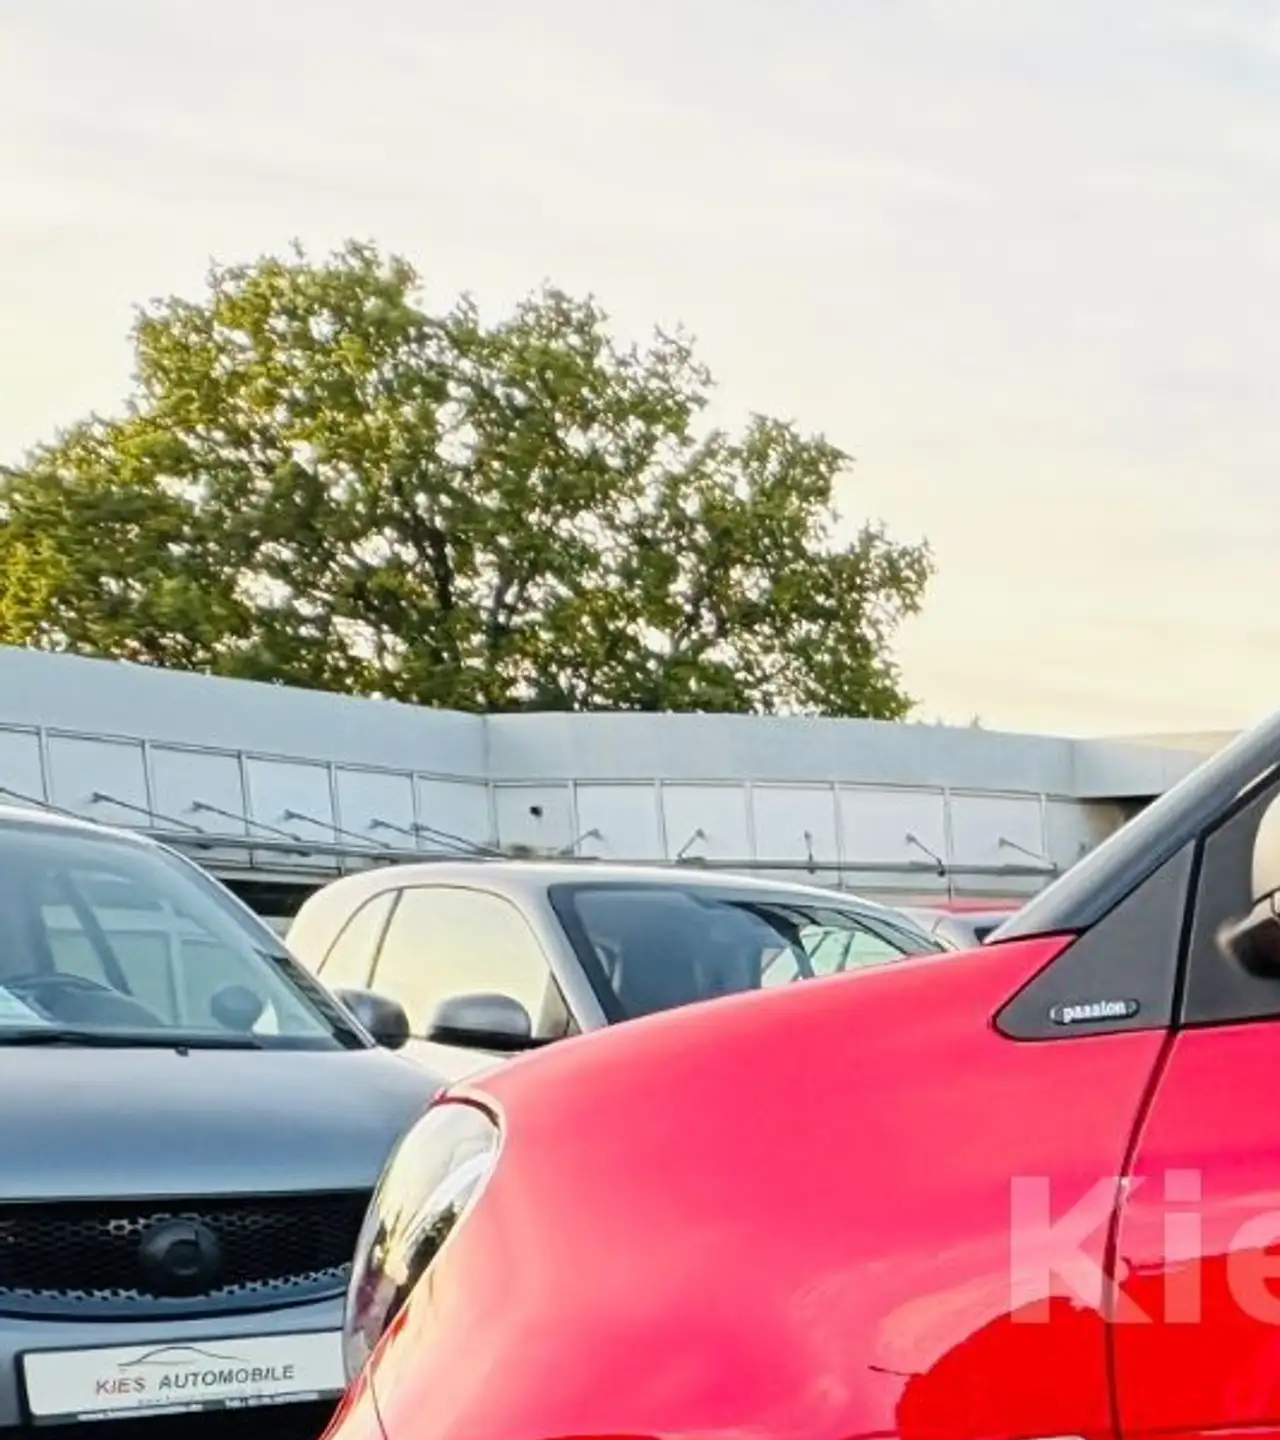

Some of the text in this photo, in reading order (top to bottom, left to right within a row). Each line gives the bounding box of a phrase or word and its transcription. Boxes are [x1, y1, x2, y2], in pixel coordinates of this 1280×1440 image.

[1062, 1000, 1128, 1024] passion
[95, 1364, 296, 1395] KIES AUTOMOBILE
